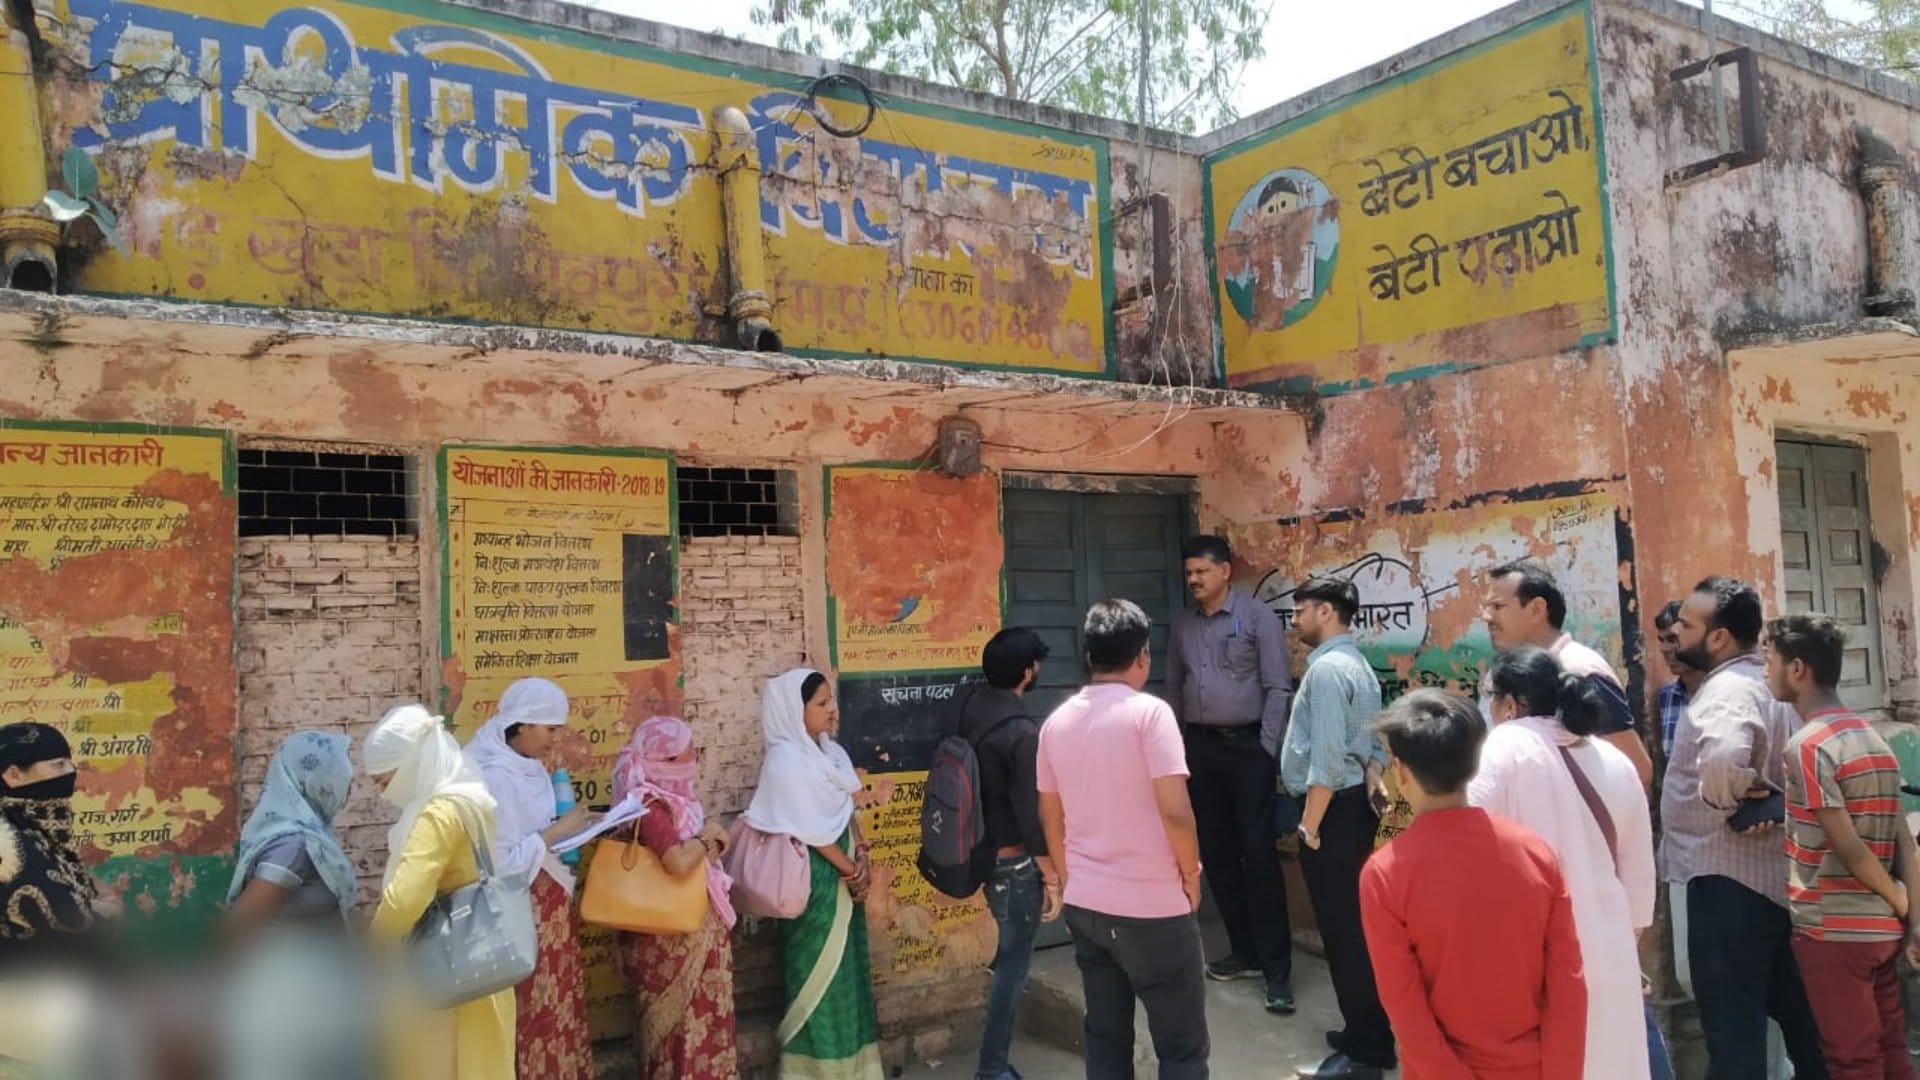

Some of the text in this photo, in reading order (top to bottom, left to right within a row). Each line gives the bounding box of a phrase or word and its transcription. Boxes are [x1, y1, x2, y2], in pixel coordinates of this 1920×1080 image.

[68, 0, 706, 217] प्राथमिक
[1358, 146, 1440, 217] बेटी
[1368, 233, 1449, 301] बेटी
[950, 273, 975, 296] का
[52, 437, 165, 467] जानकारी
[452, 455, 526, 490] योजनाओं
[528, 459, 550, 491] की
[54, 491, 72, 510] श्री
[74, 496, 119, 511] रामनाथ
[515, 529, 552, 549] भोजन
[553, 531, 594, 550] वितरण
[561, 602, 596, 617] योजना
[1350, 601, 1415, 630] भारत
[565, 624, 597, 640] योजना
[543, 651, 580, 665] योजना
[102, 691, 121, 710] श्री
[881, 683, 955, 706] सूचना पटल
[79, 736, 98, 757] श्री
